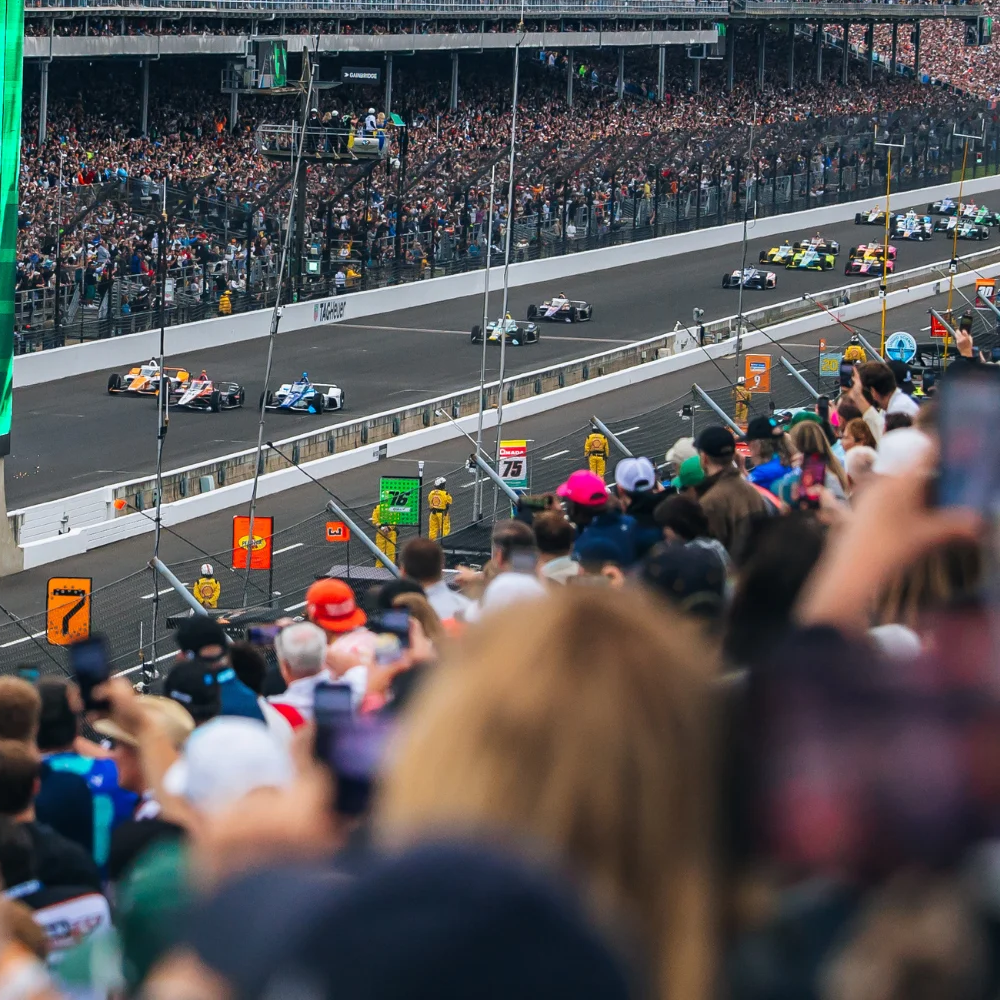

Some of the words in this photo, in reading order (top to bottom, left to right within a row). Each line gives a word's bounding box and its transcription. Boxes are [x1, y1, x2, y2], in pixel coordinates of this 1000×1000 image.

[821, 358, 838, 371] 20
[754, 375, 761, 386] 9
[502, 461, 523, 477] 75
[388, 490, 411, 506] 76
[54, 589, 85, 634] 7
